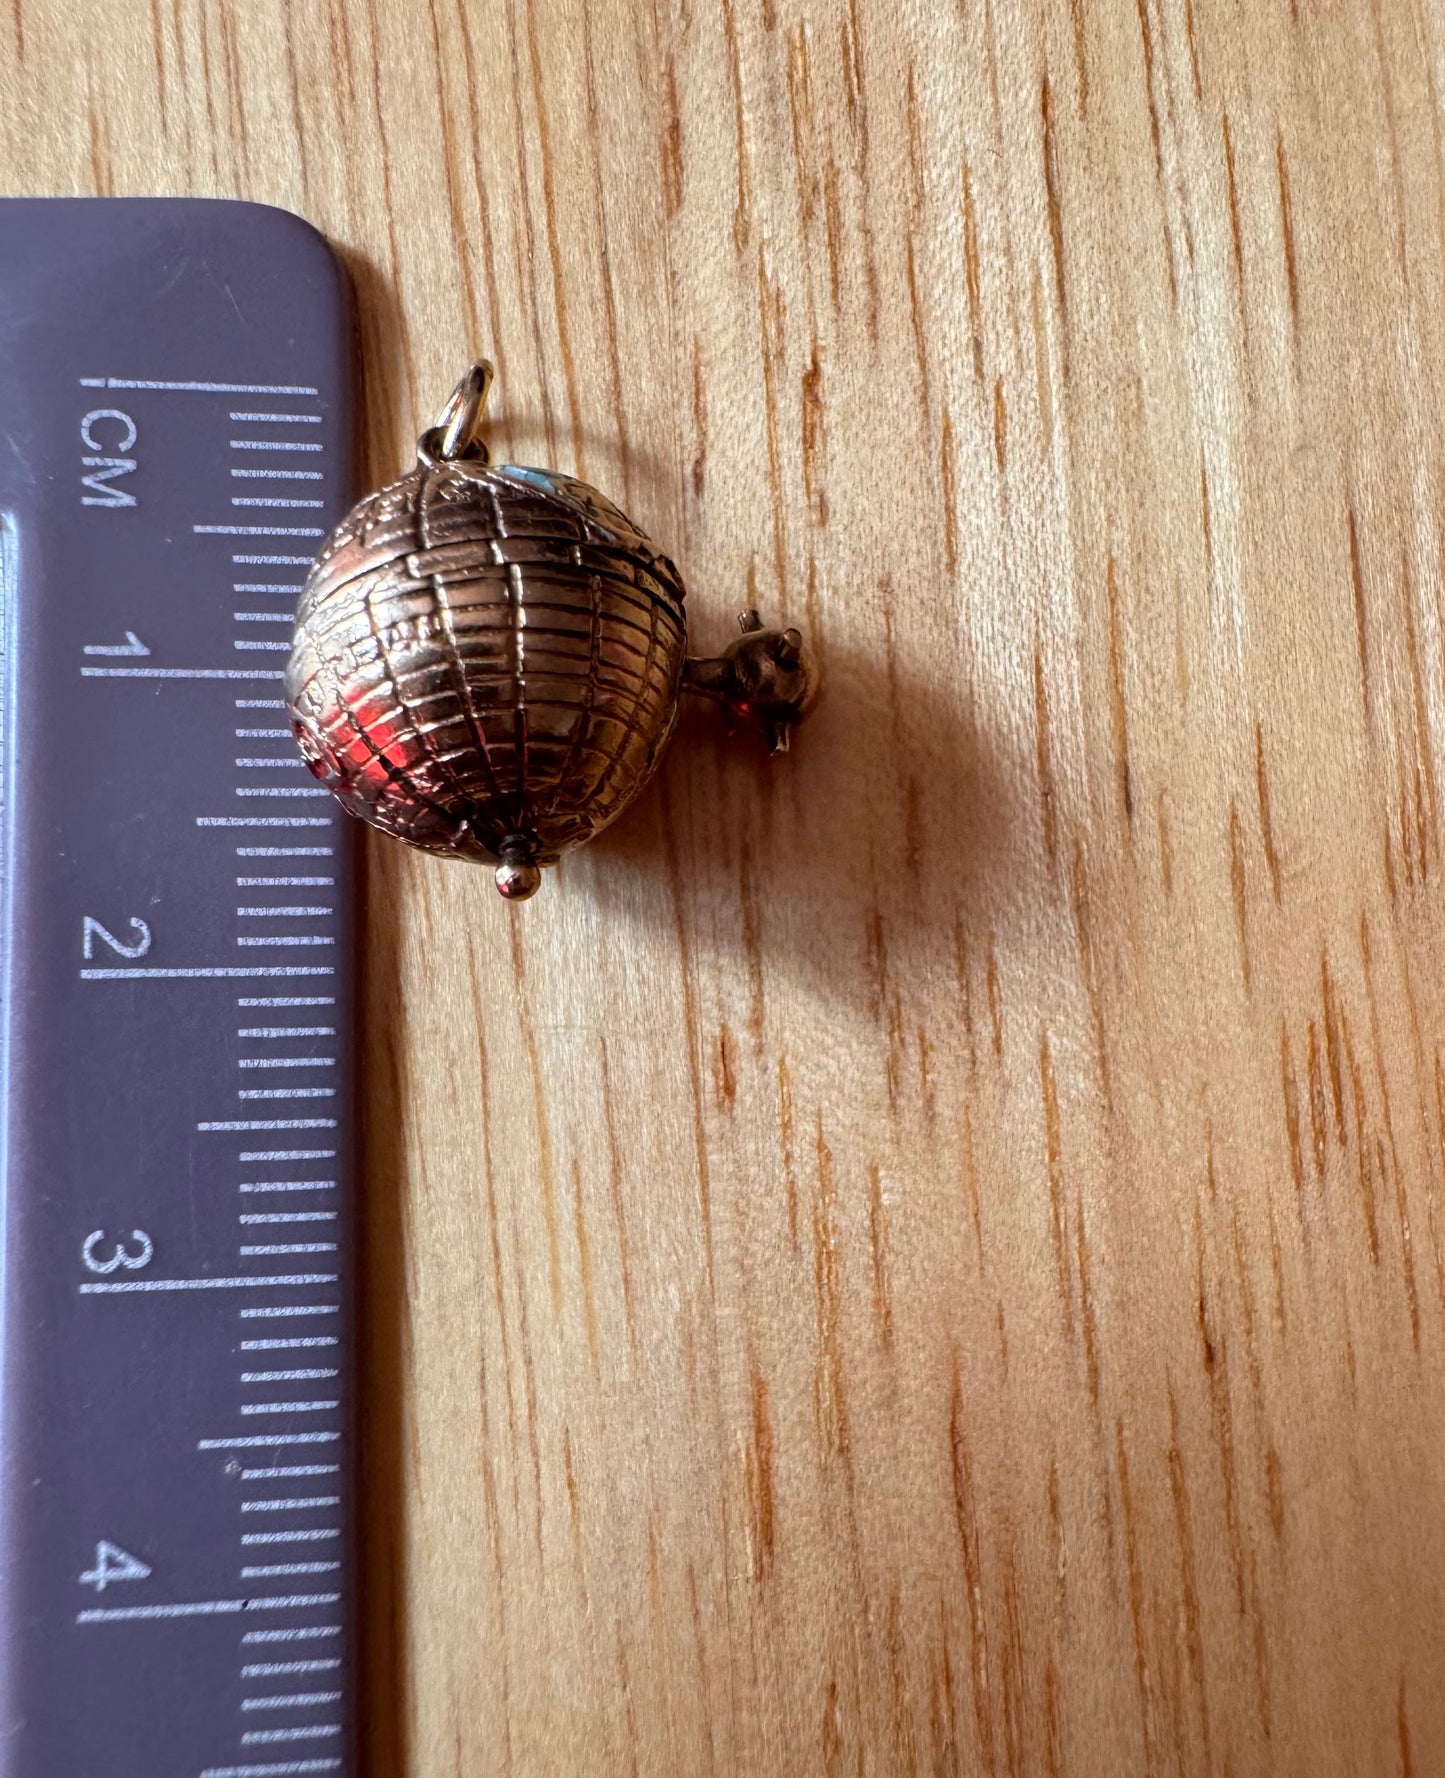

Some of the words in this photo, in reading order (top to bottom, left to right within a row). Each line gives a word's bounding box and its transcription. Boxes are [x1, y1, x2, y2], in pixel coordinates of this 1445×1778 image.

[80, 408, 137, 507] CM
[83, 631, 151, 656] 1
[83, 916, 151, 959] 2
[82, 1229, 154, 1274] 3
[79, 1540, 152, 1591] 4
